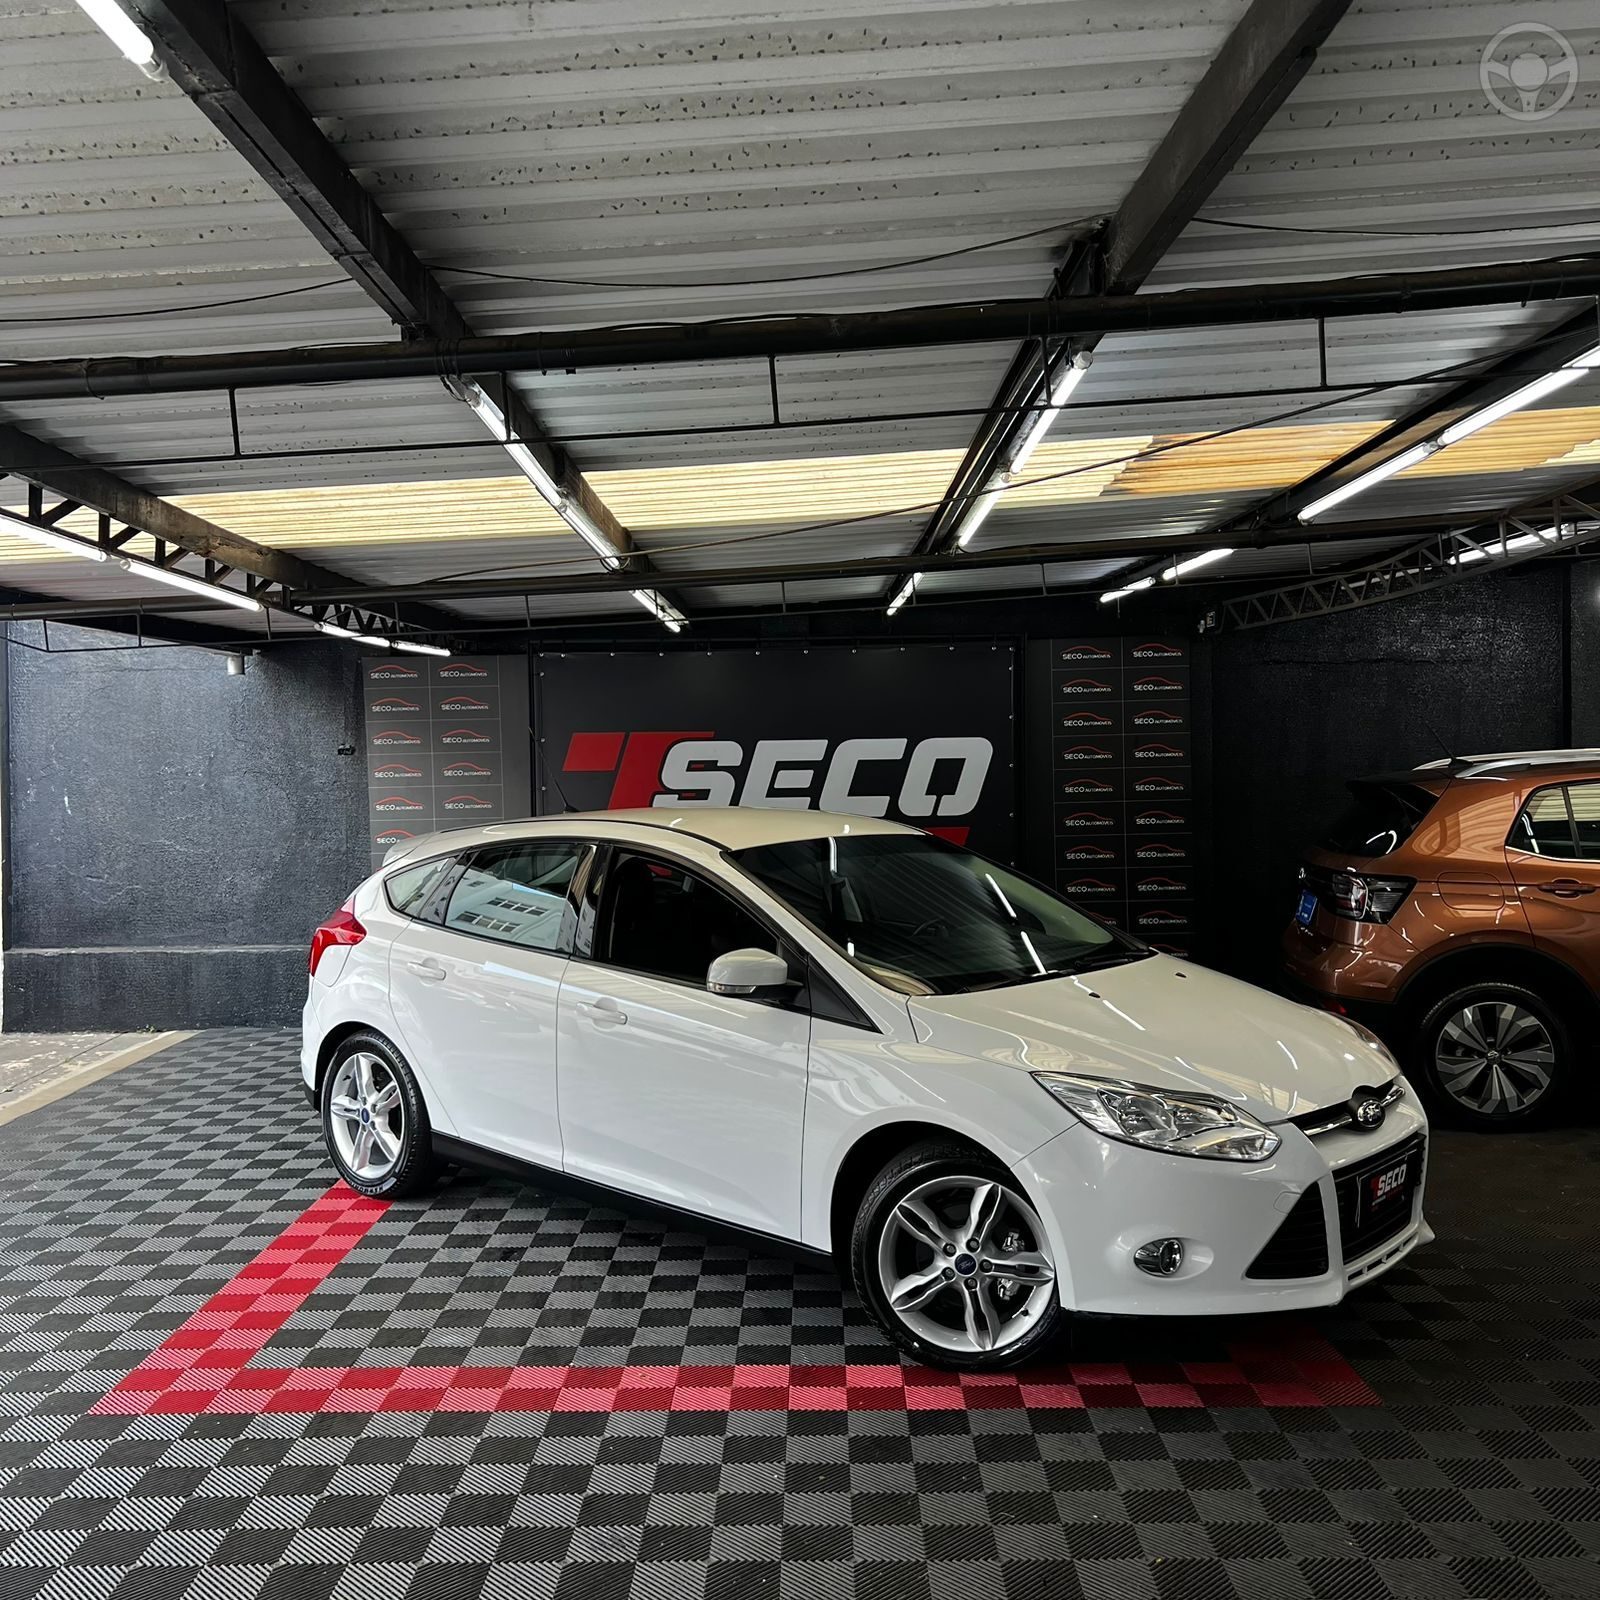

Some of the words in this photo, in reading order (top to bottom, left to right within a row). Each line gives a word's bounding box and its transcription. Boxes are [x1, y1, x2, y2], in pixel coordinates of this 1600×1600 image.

[1133, 650, 1153, 658] SECO
[440, 670, 459, 678] SECO
[1063, 686, 1083, 694] SECO
[443, 736, 462, 744] SECO
[1136, 784, 1155, 792] SECO
[445, 802, 464, 810] SECO
[1066, 852, 1086, 860] SECO
[1138, 884, 1158, 892] SECO
[1377, 1163, 1407, 1197] SECO
